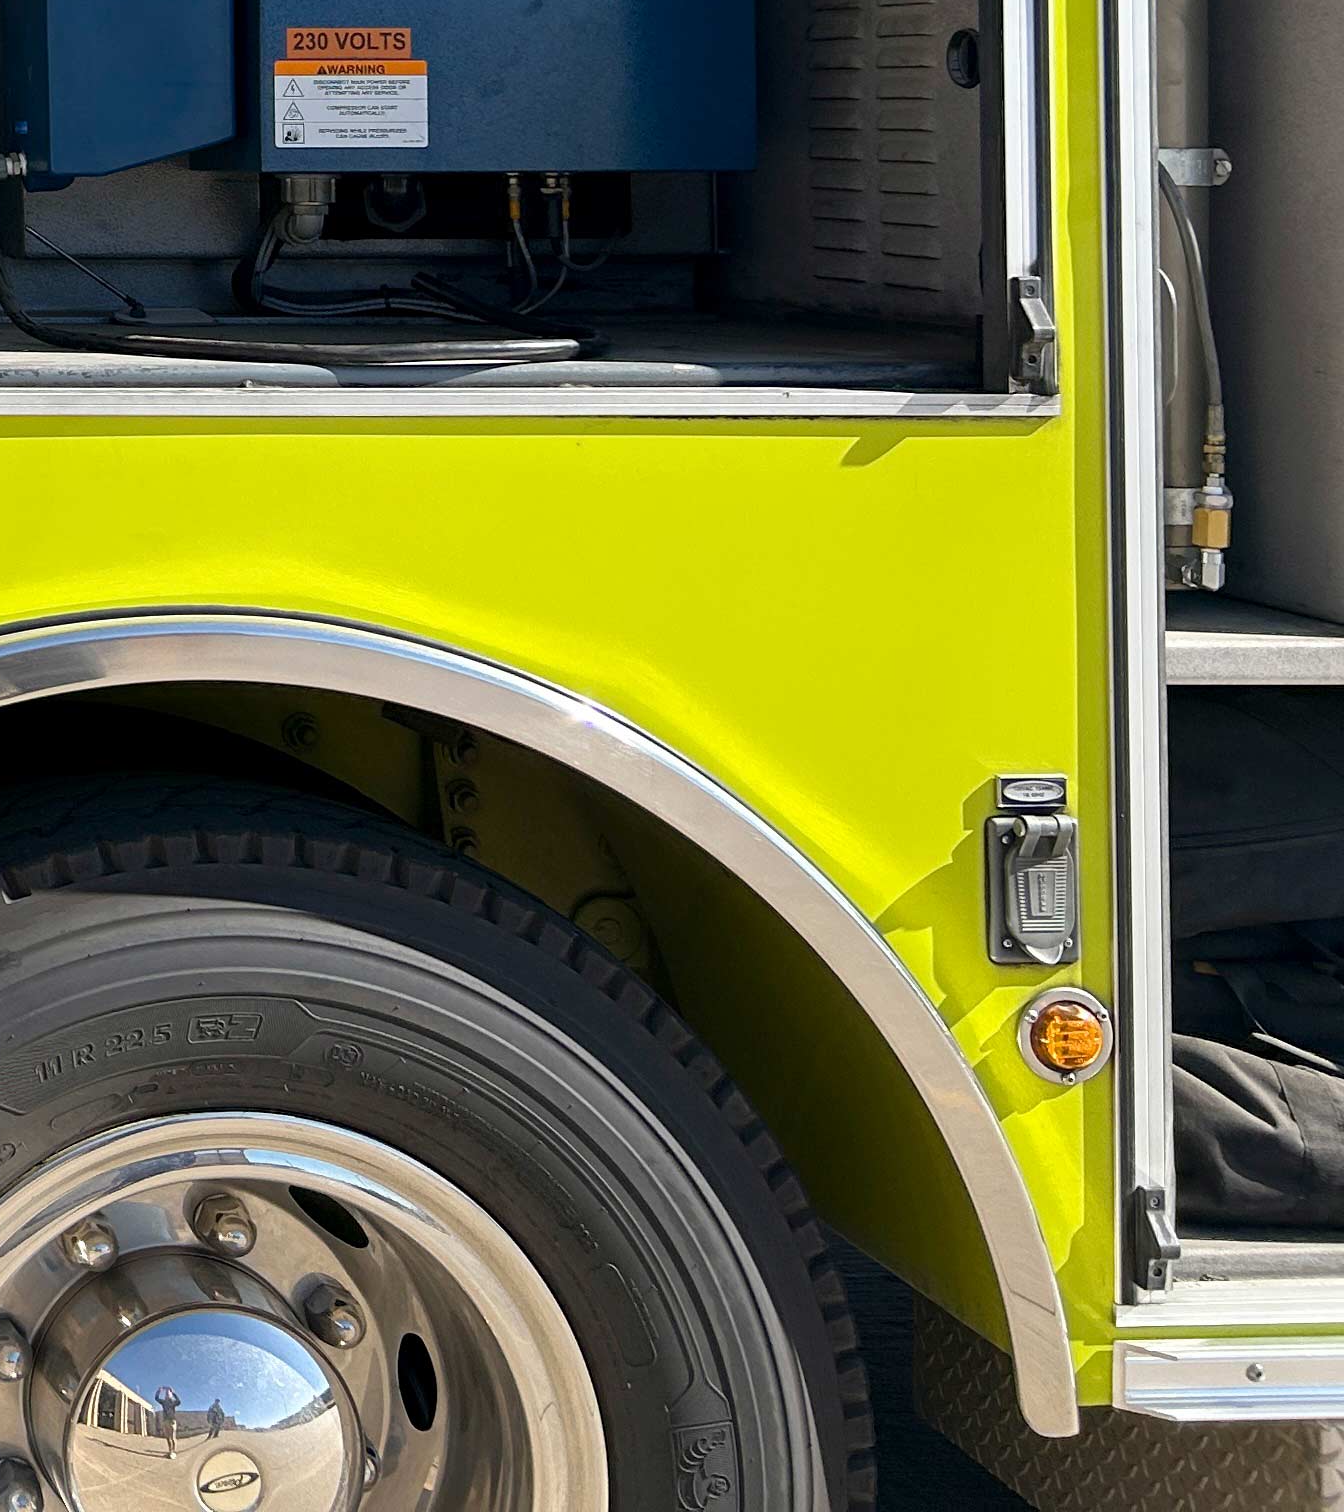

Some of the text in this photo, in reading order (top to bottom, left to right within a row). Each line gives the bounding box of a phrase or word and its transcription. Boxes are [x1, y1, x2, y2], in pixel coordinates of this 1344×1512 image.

[293, 32, 406, 50] 230 VOLTS
[327, 65, 385, 74] WARNING
[71, 1043, 96, 1069] R
